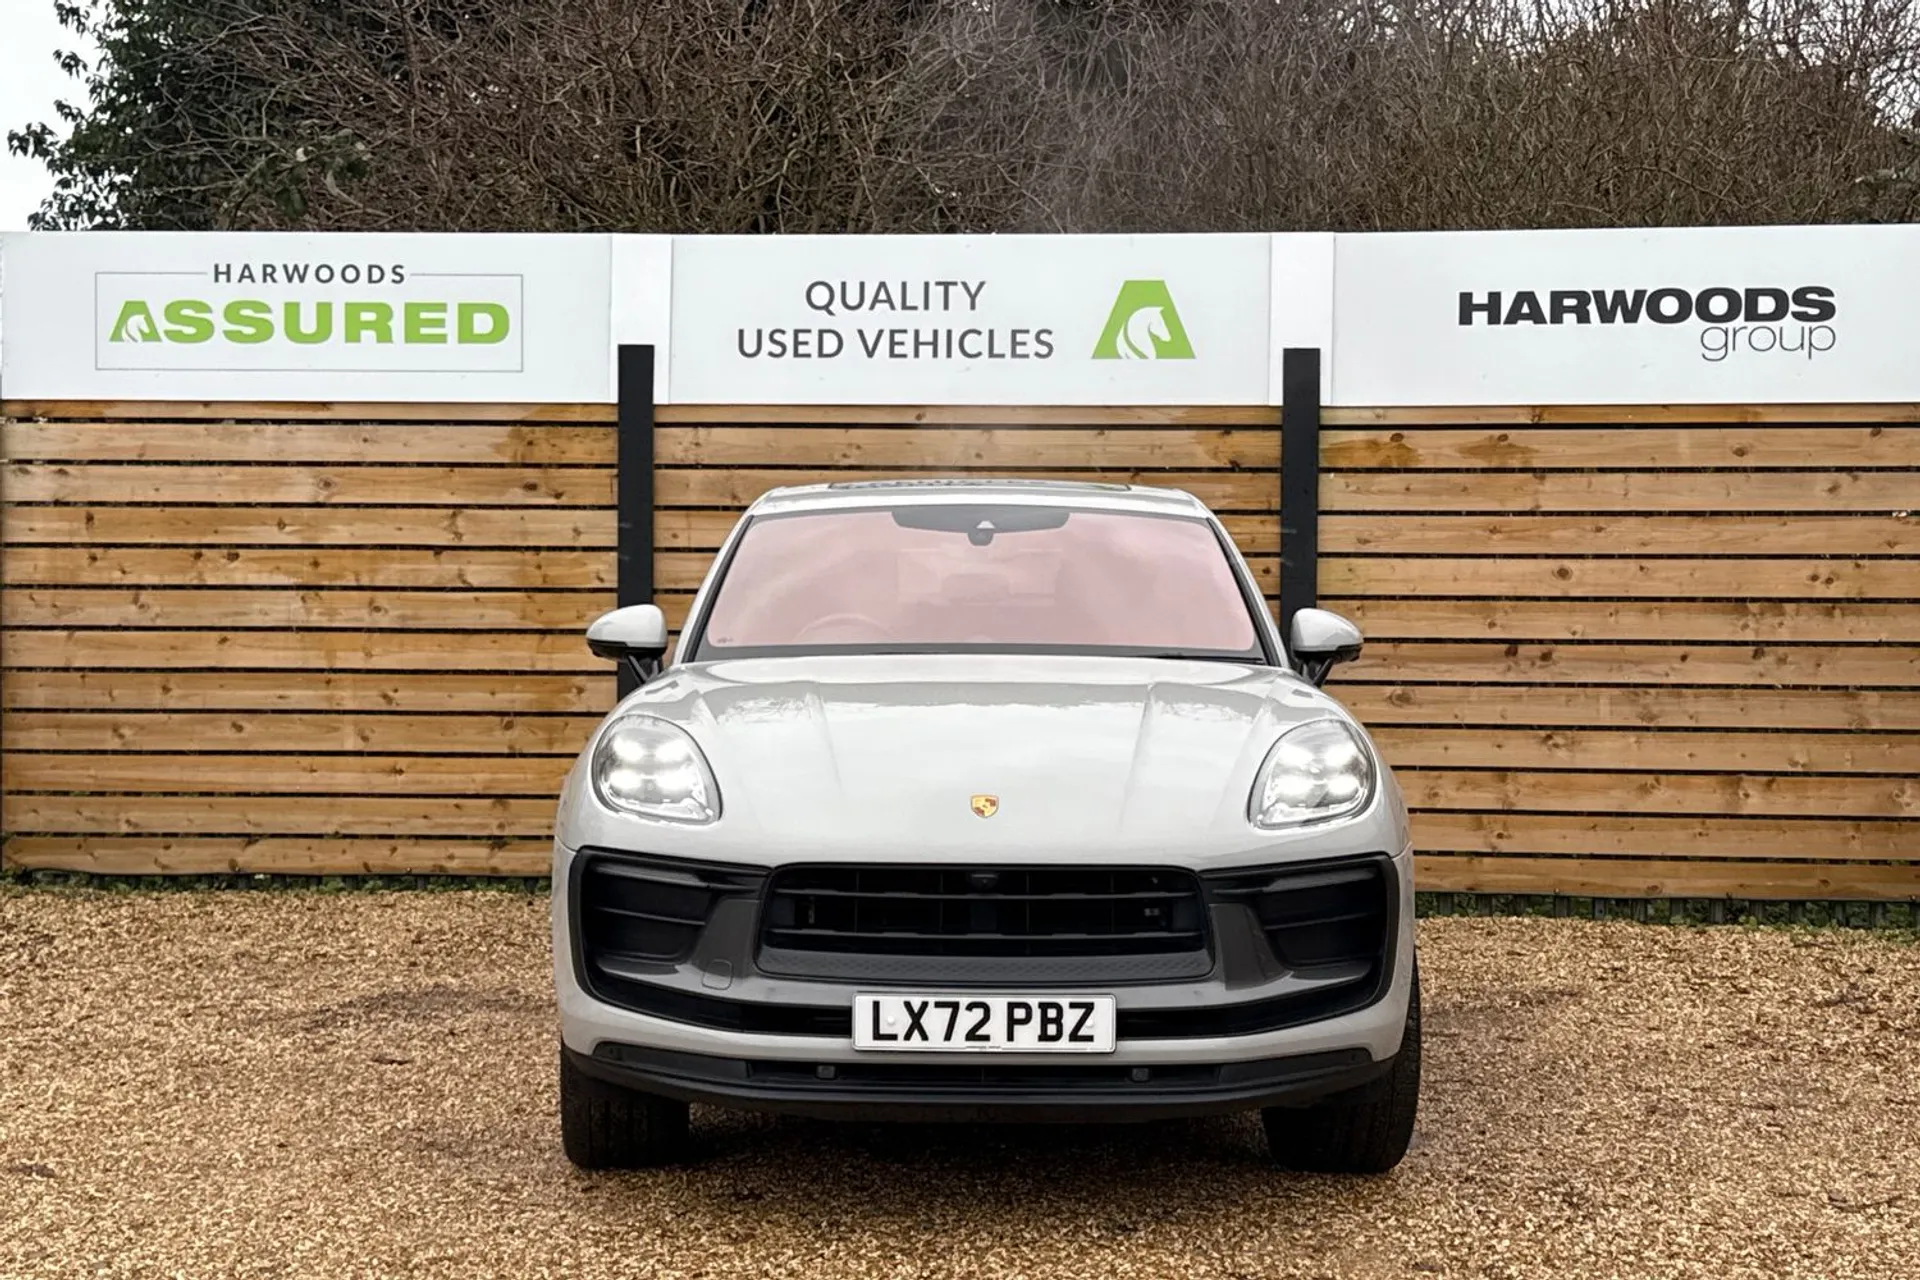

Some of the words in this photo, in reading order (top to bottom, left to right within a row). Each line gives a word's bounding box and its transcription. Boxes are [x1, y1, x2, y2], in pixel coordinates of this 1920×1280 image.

[214, 263, 406, 284] HARWOODS
[805, 280, 986, 316] QUALITY
[1458, 286, 1837, 326] HARWOODS
[109, 300, 510, 344] ASSURED
[737, 328, 844, 359] USED
[857, 328, 1054, 359] VEHICLES
[1700, 325, 1837, 362] group
[872, 1001, 991, 1042] LX72
[1006, 1001, 1095, 1042] PBZ
